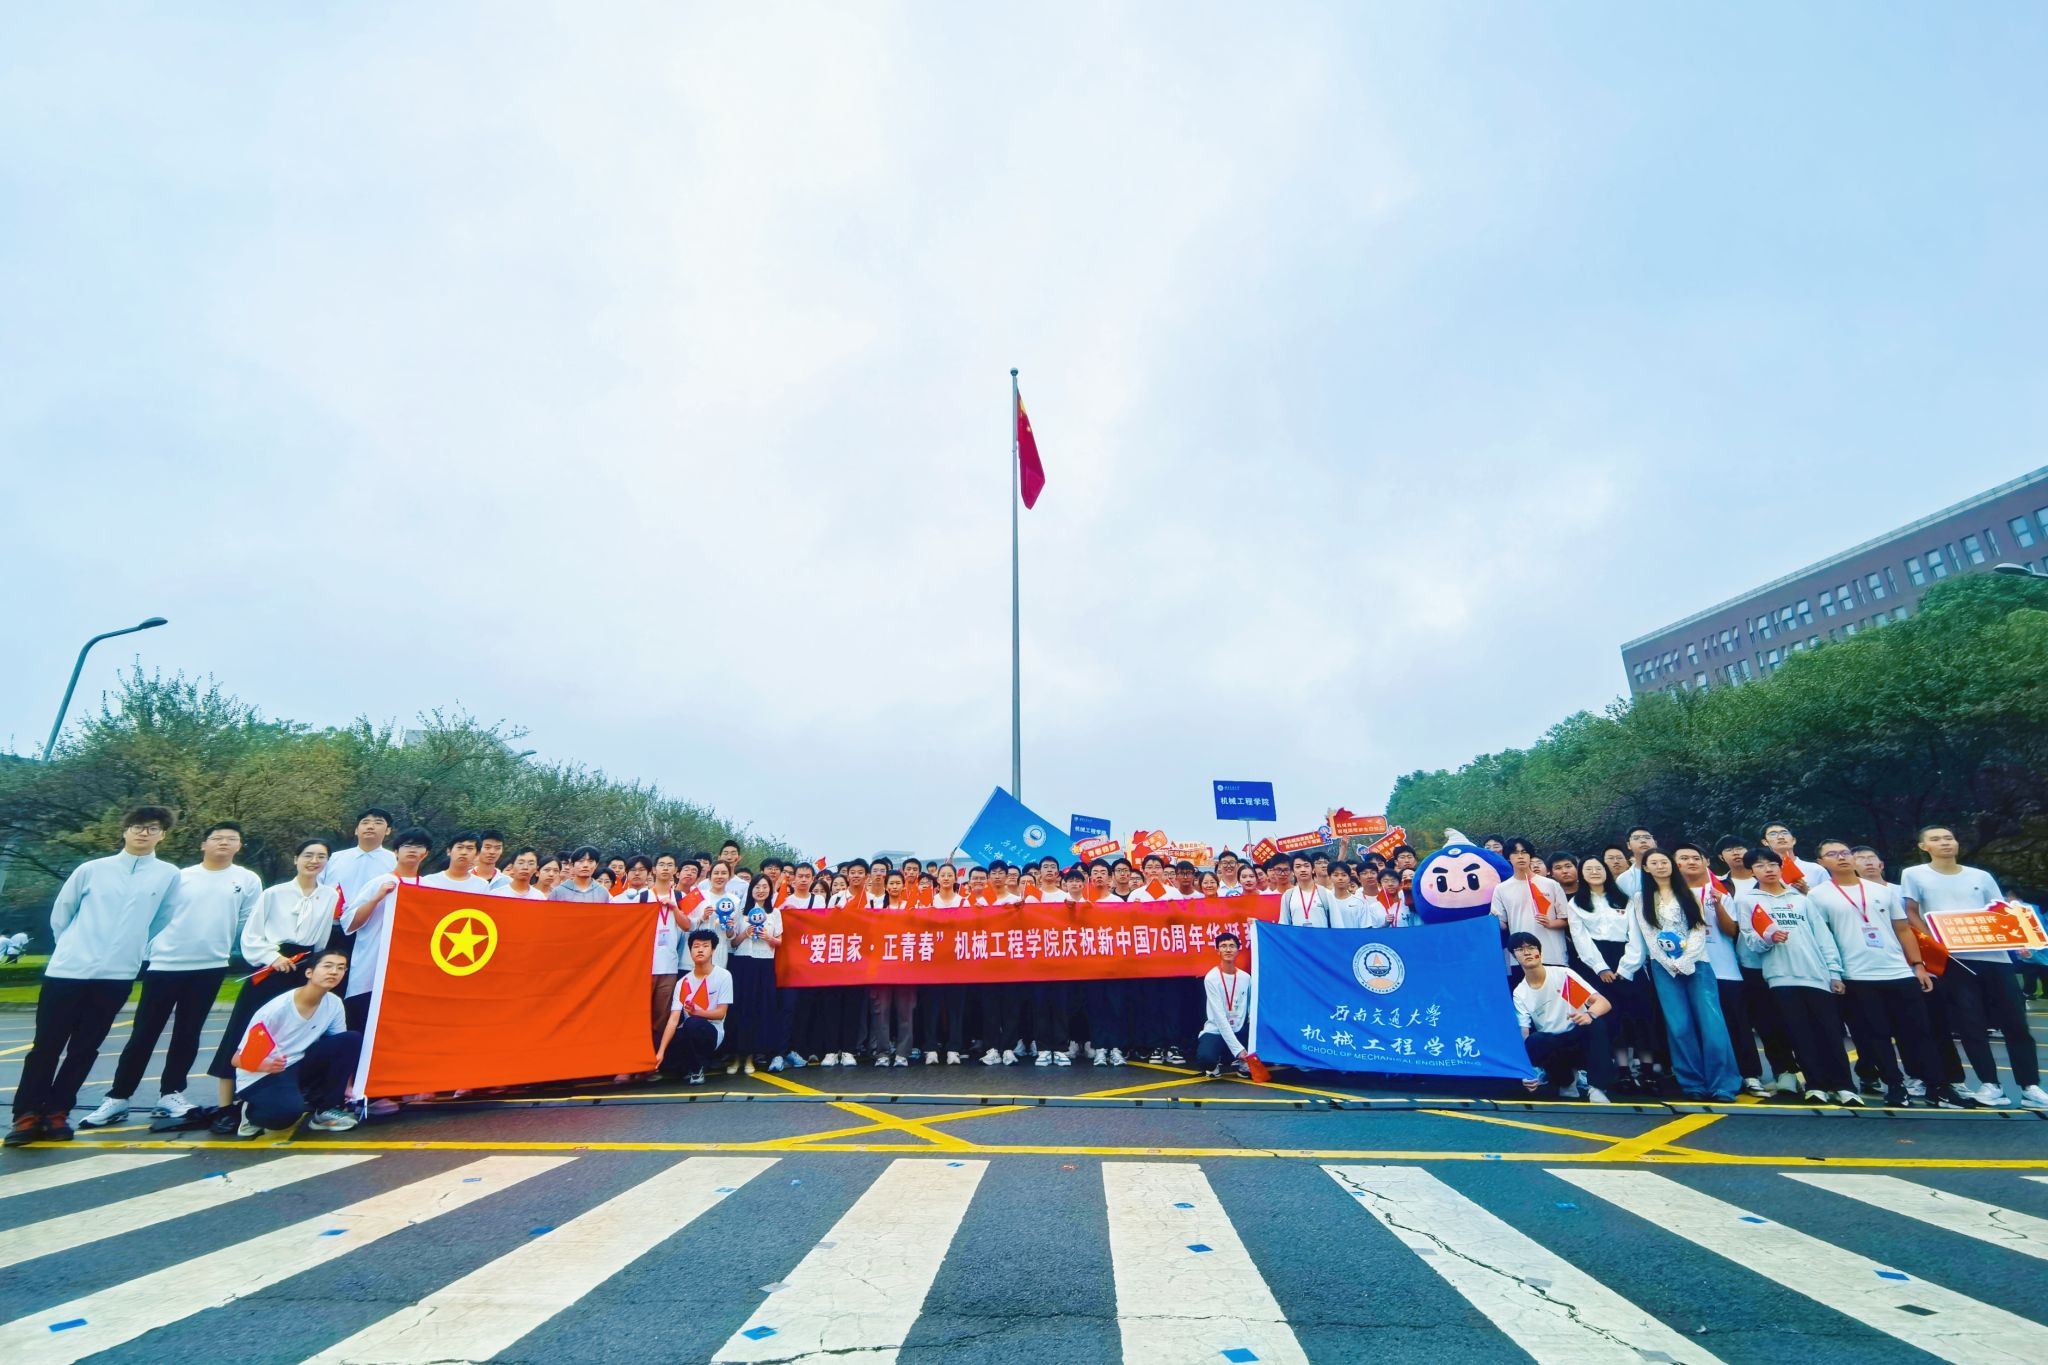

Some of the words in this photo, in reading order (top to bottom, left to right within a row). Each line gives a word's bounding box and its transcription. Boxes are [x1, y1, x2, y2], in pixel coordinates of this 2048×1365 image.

[1220, 796, 1270, 807] 机械工程学院
[1300, 1024, 1481, 1059] 机械工程学院
[1302, 1044, 1338, 1056] SCHOOL
[1354, 1053, 1412, 1065] MECHANICAL
